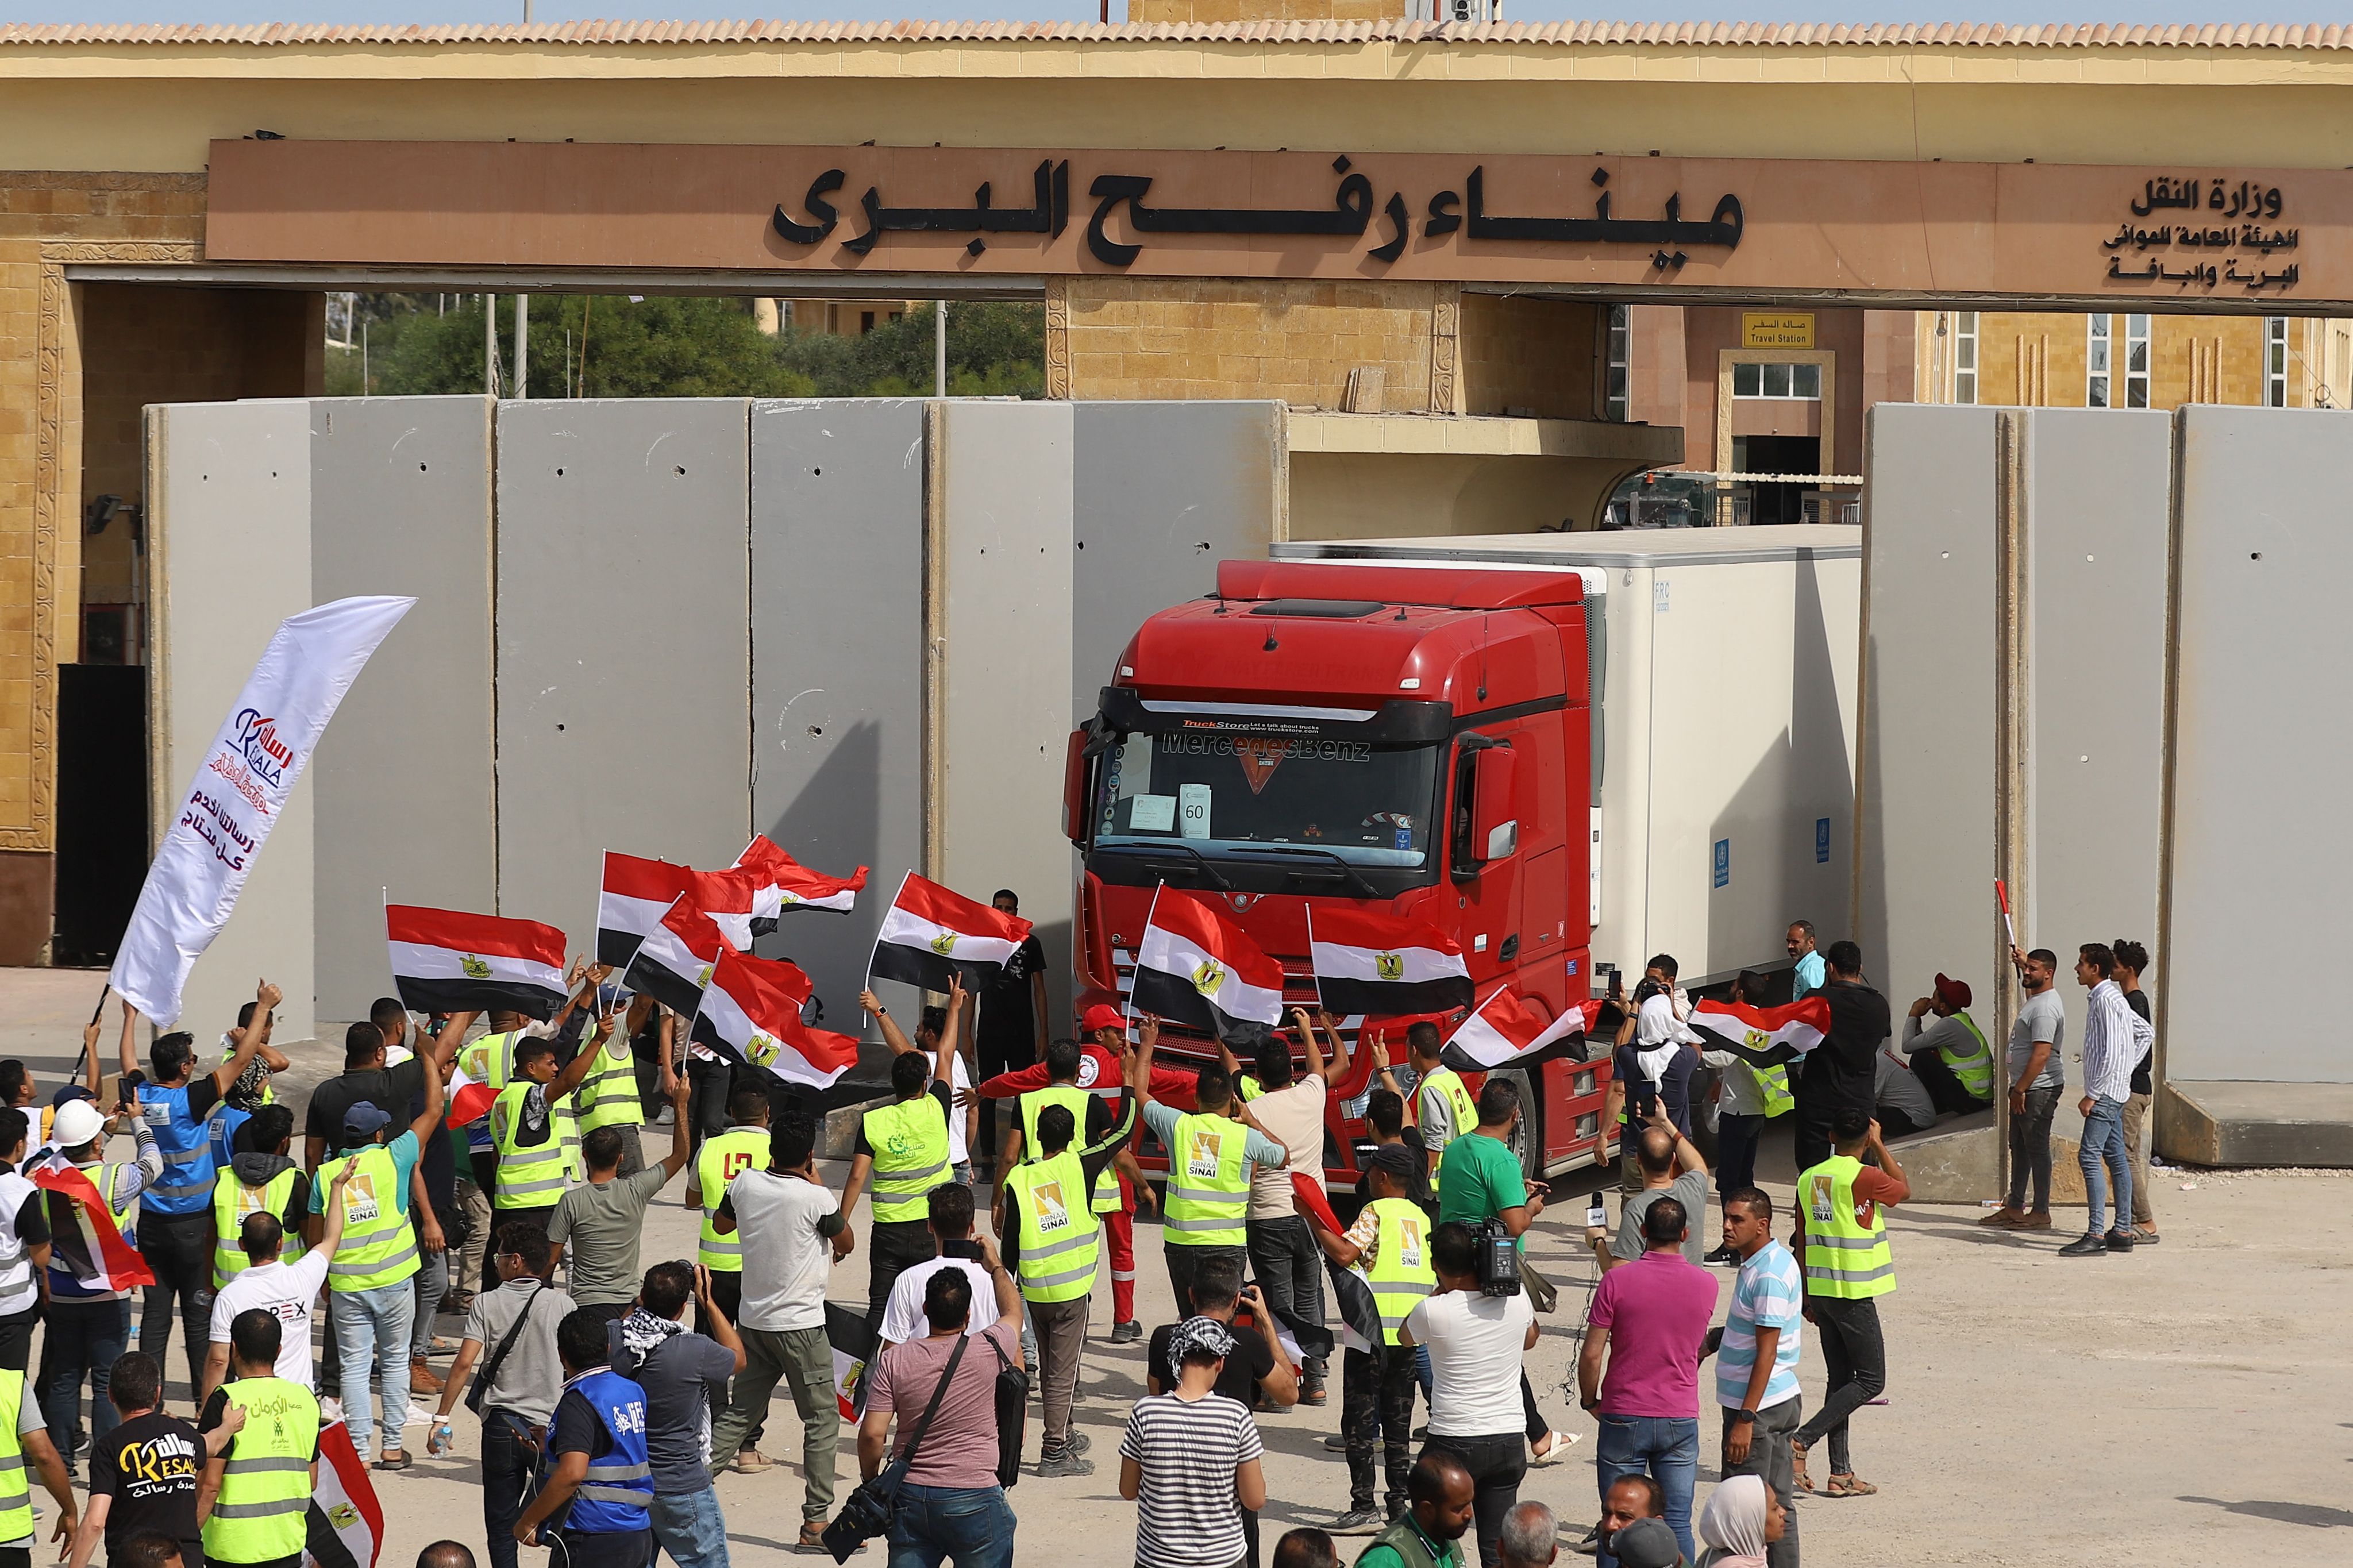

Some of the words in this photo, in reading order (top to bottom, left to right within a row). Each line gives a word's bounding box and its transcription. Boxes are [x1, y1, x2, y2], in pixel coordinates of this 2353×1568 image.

[2130, 176, 2198, 217] النقل
[2208, 178, 2282, 219] وزارة
[1087, 153, 1410, 266] رفح
[1424, 164, 1744, 271] ميناء
[2174, 226, 2236, 246] العامة
[2240, 224, 2299, 253] الهيئة
[2108, 257, 2217, 287] والجافة
[2225, 259, 2299, 289] البرية
[1751, 319, 1779, 330] السفر
[1751, 334, 1775, 342] Travel
[1778, 334, 1805, 342] Station
[1655, 582, 1669, 599] FRC
[1184, 720, 1250, 729] TruckStore
[1185, 805, 1203, 819] 60
[180, 810, 217, 847] محتاج
[218, 808, 255, 854] رسالتنا
[216, 842, 245, 872] كل
[1189, 1166, 1216, 1178] SINAI
[1190, 1160, 1216, 1170] ABNAA
[349, 1204, 377, 1215] ABNAA
[350, 1211, 379, 1223] SINAI
[1040, 1212, 1066, 1224] ABNAA
[1813, 1212, 1832, 1220] SINAI
[1041, 1218, 1068, 1231] SINAI
[1402, 1257, 1419, 1266] SINAI
[251, 1394, 288, 1418] الأورمان
[155, 1432, 196, 1458] سالة
